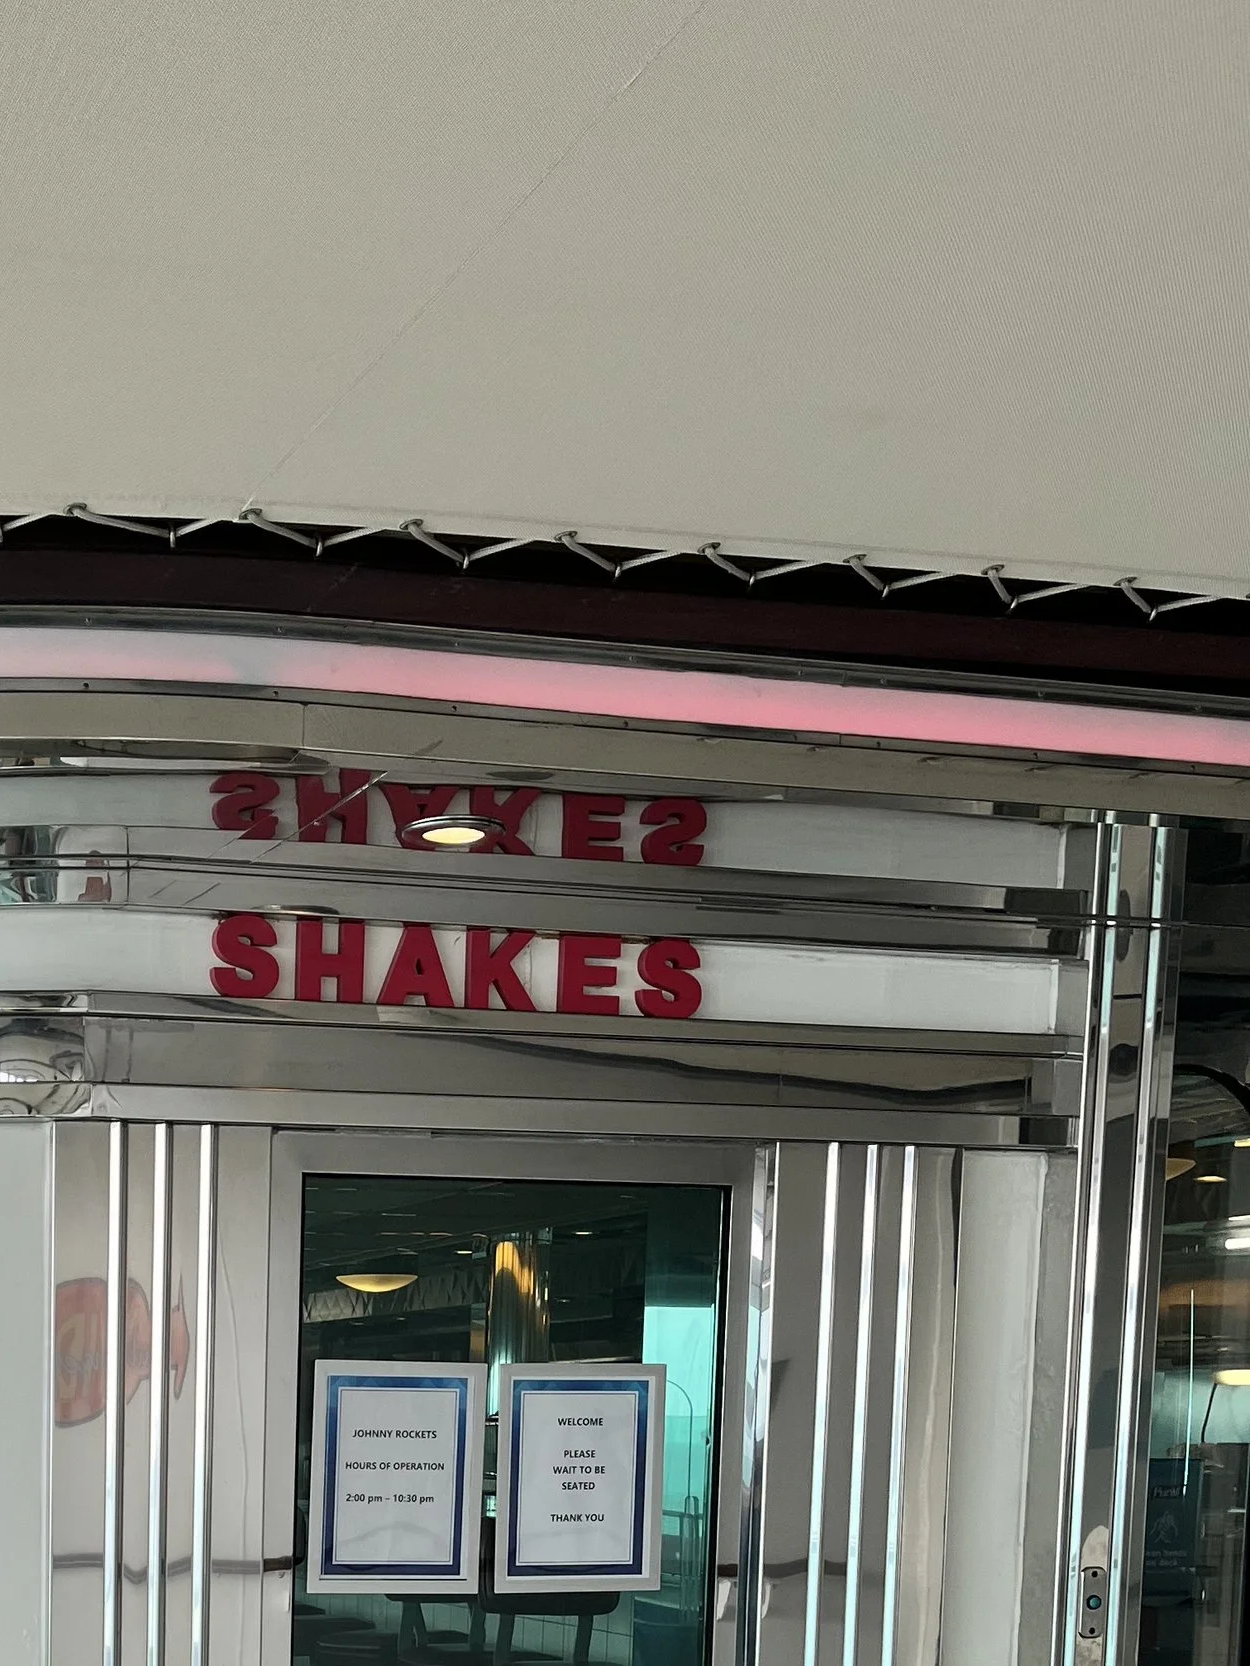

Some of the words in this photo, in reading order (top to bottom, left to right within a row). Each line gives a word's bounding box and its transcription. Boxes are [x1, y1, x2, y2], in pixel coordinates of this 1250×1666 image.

[210, 914, 702, 1019] SHAKES
[557, 1417, 604, 1427] WELCOME
[352, 1429, 393, 1439] JOHNNY
[395, 1430, 438, 1439] ROCKETS
[563, 1449, 596, 1459] PLEASE
[345, 1461, 377, 1470] HOURS
[379, 1462, 391, 1470] OF
[393, 1462, 445, 1471] OPERATION
[553, 1465, 577, 1475] WAIT
[579, 1465, 592, 1474] TO
[594, 1465, 606, 1474] BE
[561, 1481, 596, 1491] SEATED
[346, 1493, 366, 1502] 2:00
[368, 1495, 383, 1504] pm
[393, 1494, 417, 1503] 10:30
[419, 1496, 435, 1505] pm
[550, 1513, 583, 1523] THANK
[584, 1513, 605, 1523] YOU
